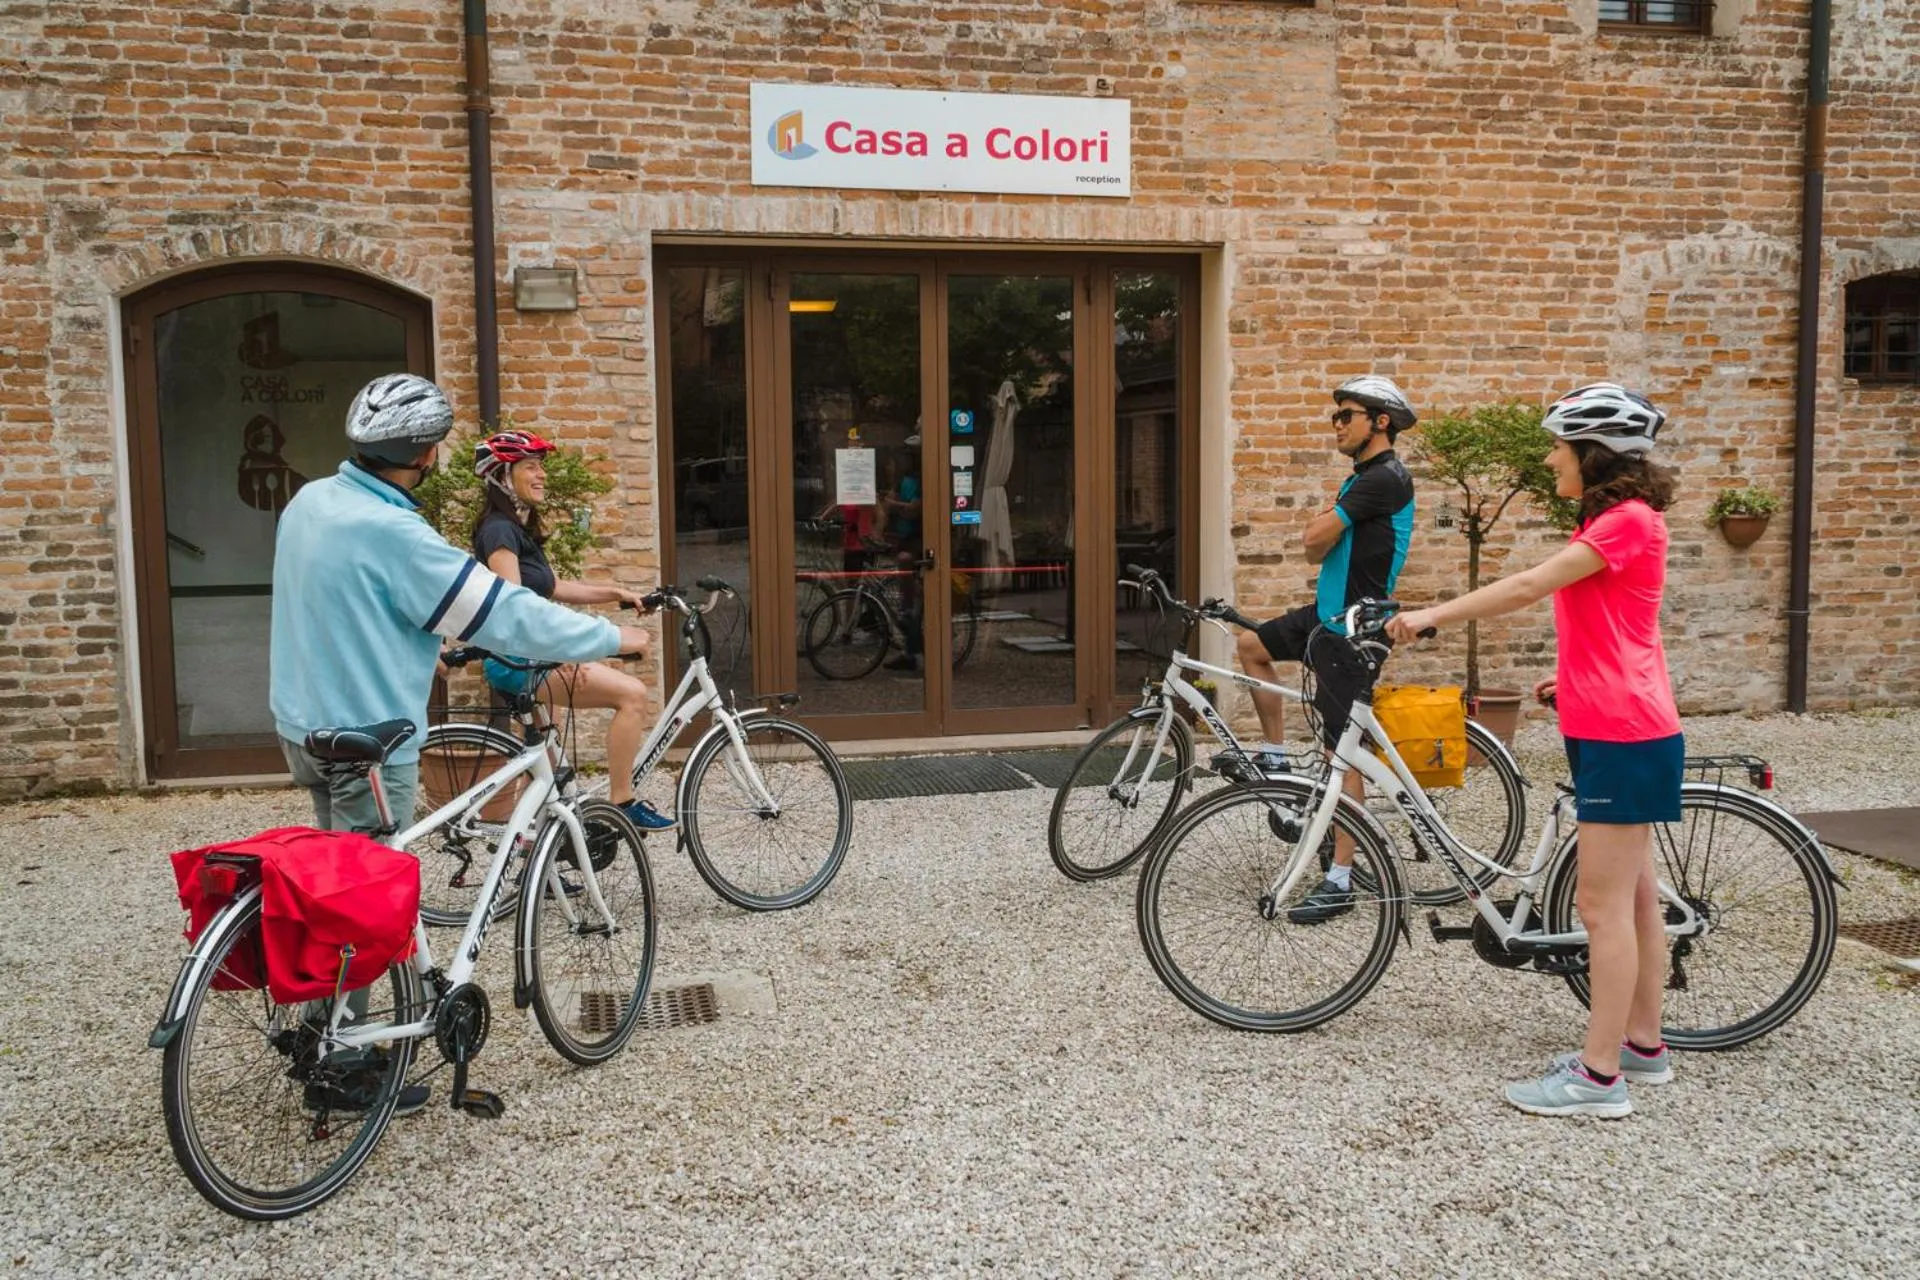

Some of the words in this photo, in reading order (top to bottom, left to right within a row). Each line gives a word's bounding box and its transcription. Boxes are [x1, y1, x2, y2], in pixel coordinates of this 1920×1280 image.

[825, 120, 928, 157] Casa
[945, 132, 968, 158] a
[985, 127, 1109, 163] Colori
[1075, 174, 1121, 185] reception
[240, 375, 289, 389] CASA
[241, 389, 254, 403] A
